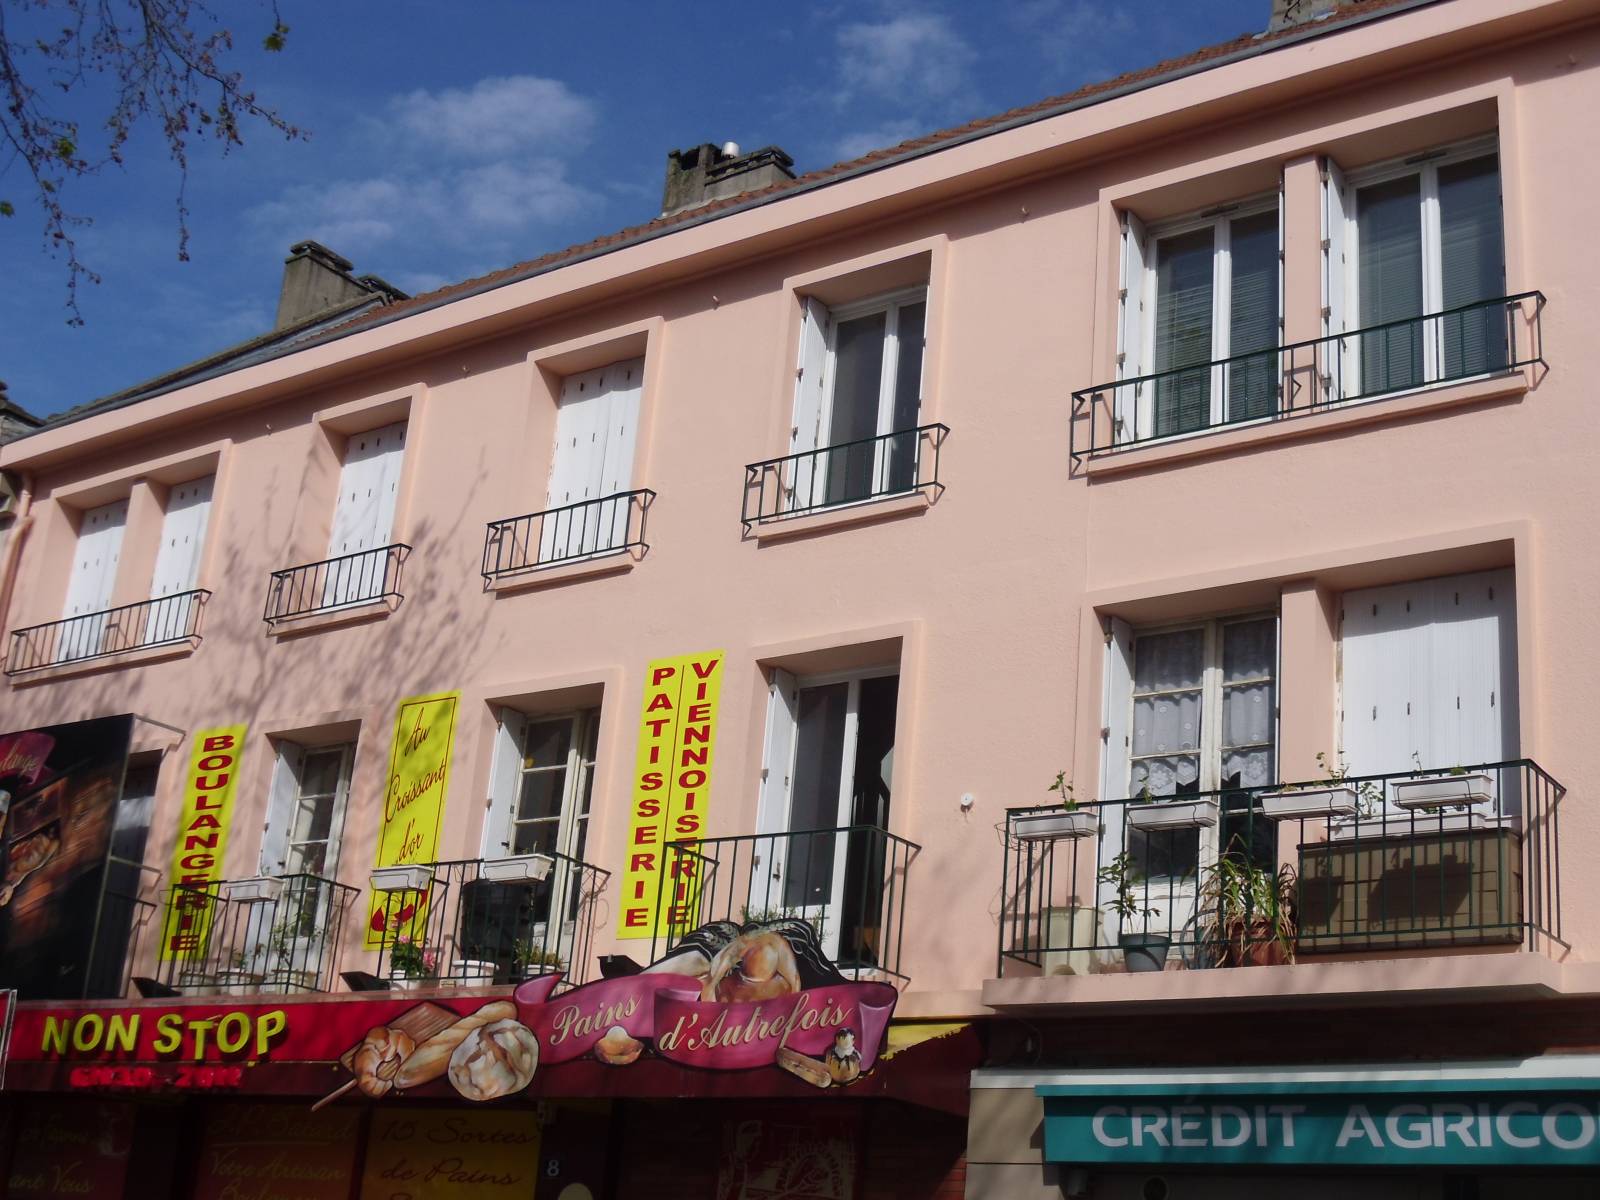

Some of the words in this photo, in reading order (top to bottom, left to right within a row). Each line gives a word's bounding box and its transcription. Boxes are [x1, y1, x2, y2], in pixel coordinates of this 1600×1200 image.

[404, 706, 432, 757] Au
[384, 758, 447, 824] Croissant
[624, 666, 676, 928] PATISSERIE
[666, 658, 720, 926] VIENNOISERIE
[169, 735, 235, 951] BOULANGERIE
[396, 818, 425, 863] d'or
[41, 1013, 140, 1055] NON
[153, 1009, 287, 1060] STOP
[549, 994, 643, 1046] Pains
[658, 992, 853, 1052] d'Autrefois
[426, 1116, 537, 1145] Sortes
[1092, 1096, 1307, 1147] CRÉDIT
[1335, 1101, 1600, 1150] AGRICO
[380, 1157, 420, 1181] de
[423, 1157, 521, 1185] Pains
[547, 1159, 560, 1177] 8
